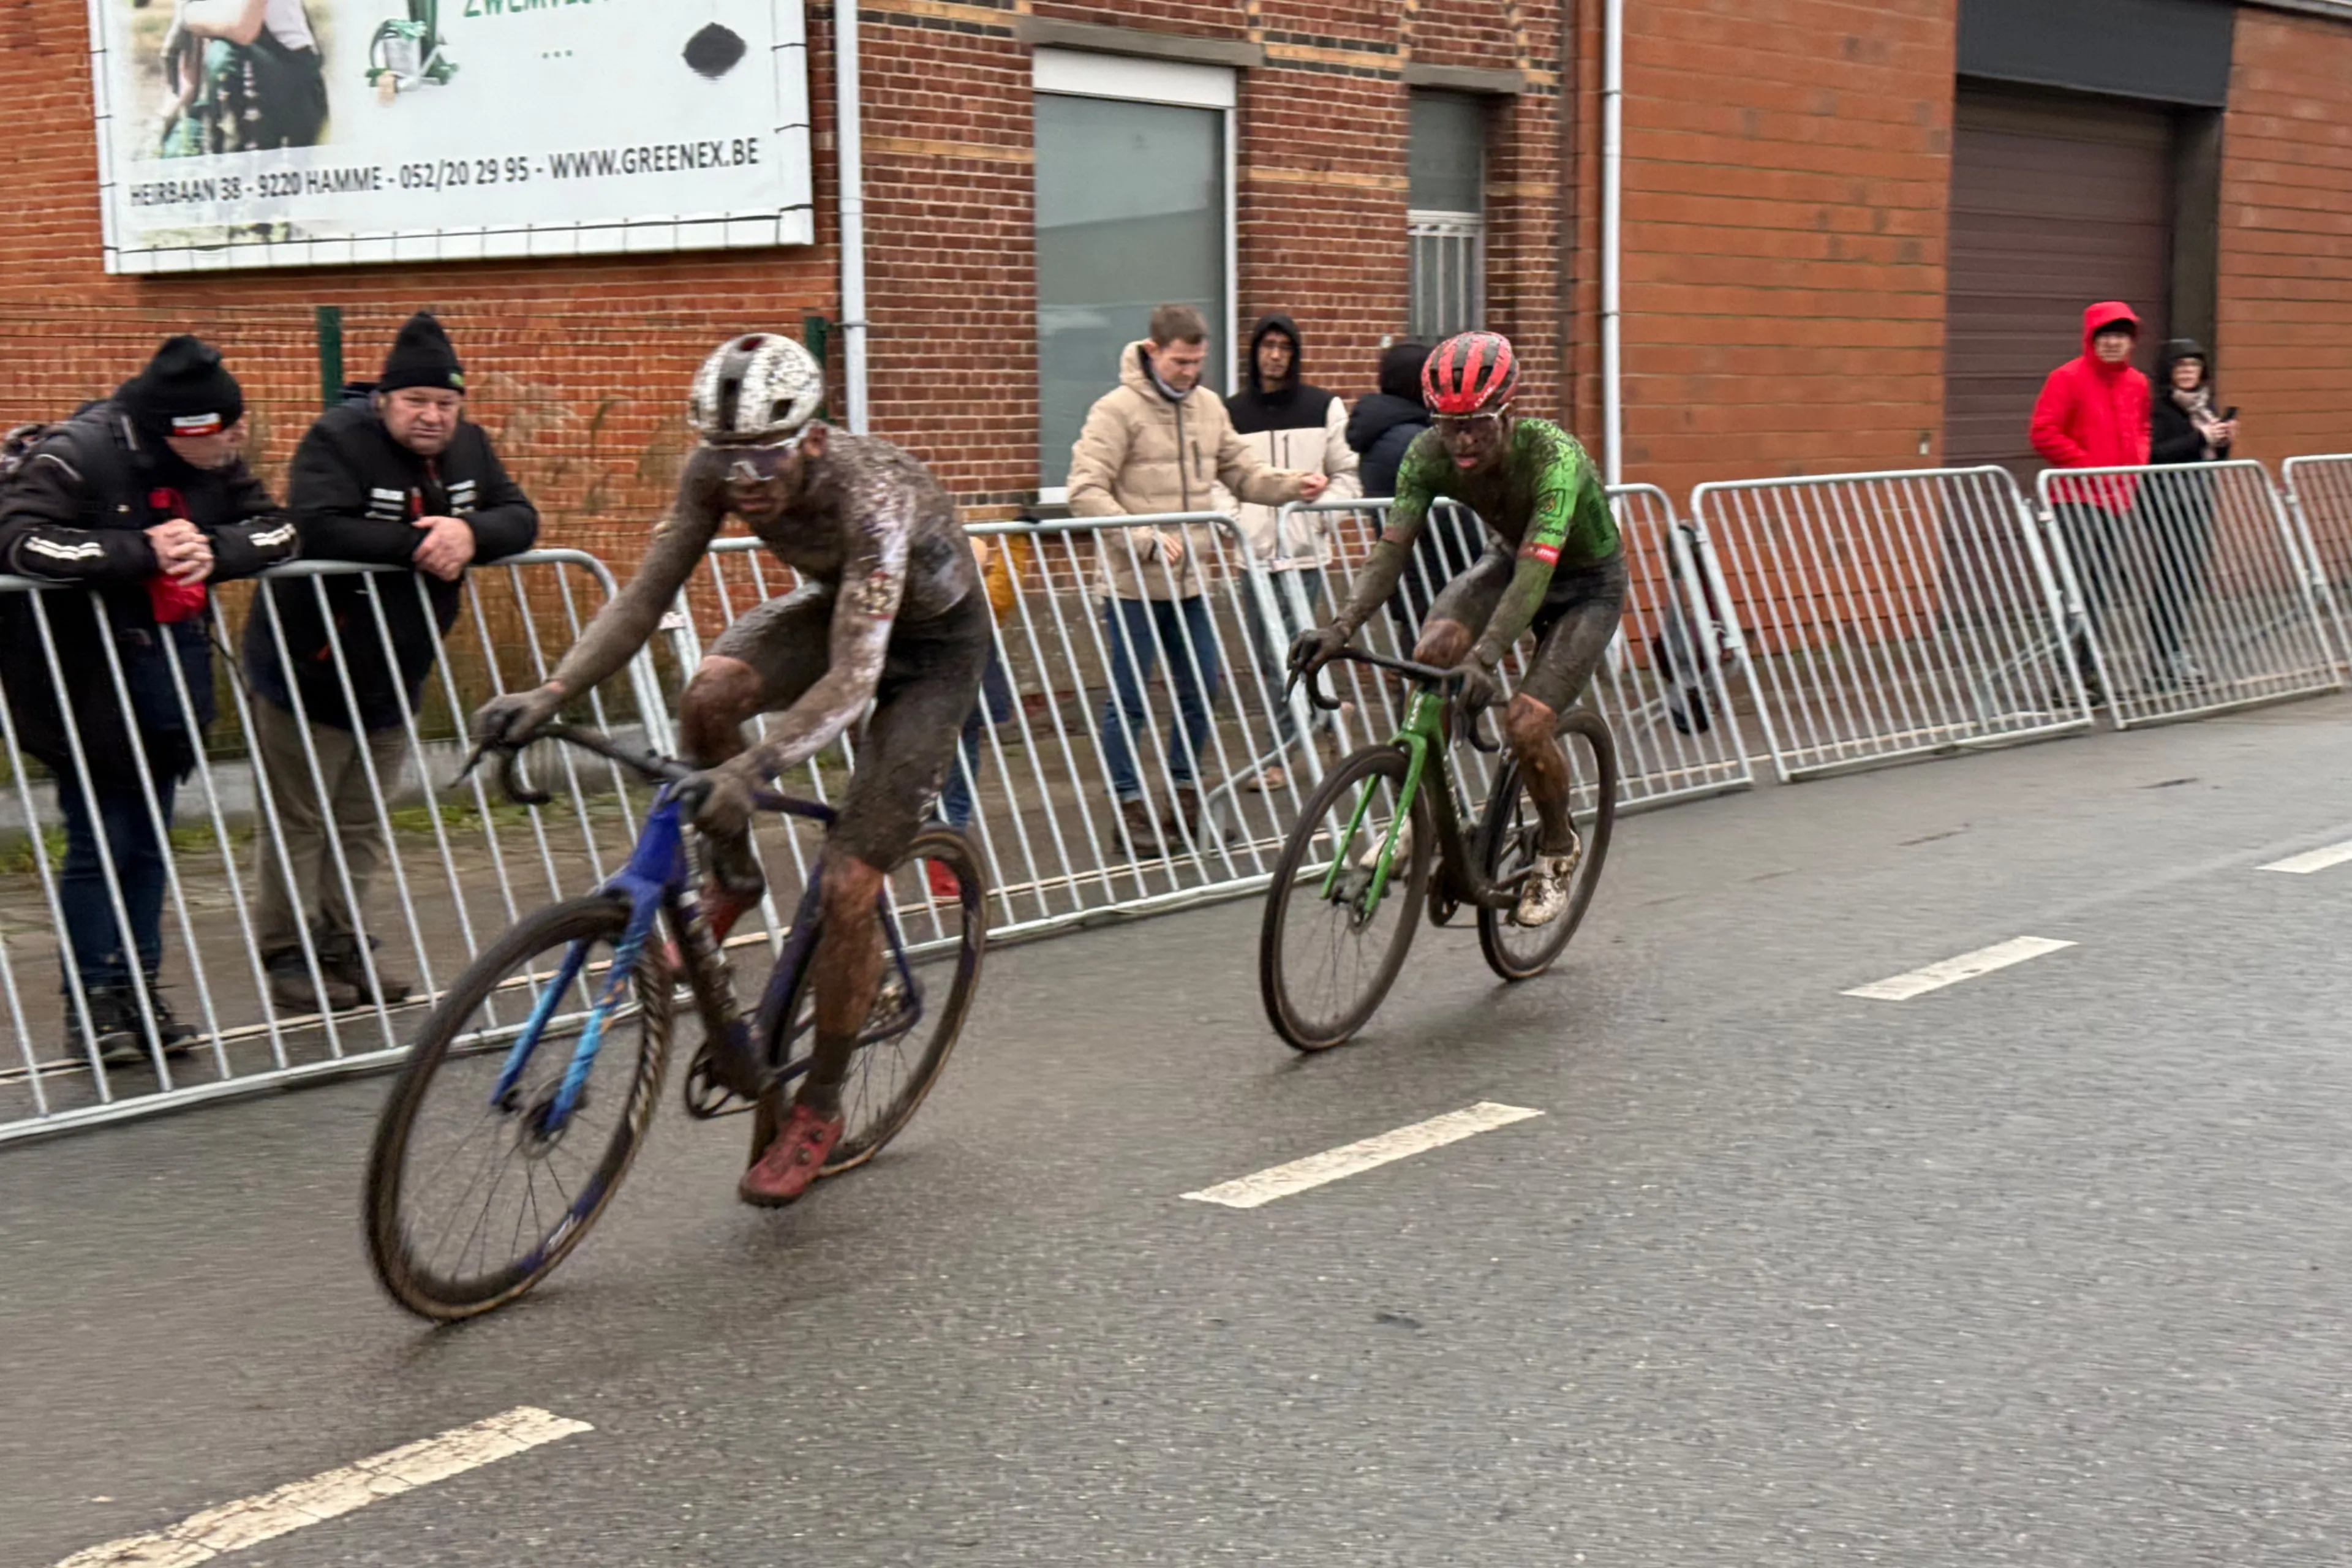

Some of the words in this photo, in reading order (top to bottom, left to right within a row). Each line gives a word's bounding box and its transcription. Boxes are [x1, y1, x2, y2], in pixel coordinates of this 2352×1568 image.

[130, 179, 216, 206] HEIRBAAN
[257, 172, 302, 198] 9220
[306, 166, 382, 194] HAMME
[400, 159, 469, 192] 052/20
[476, 158, 498, 186] 29
[505, 156, 529, 183] 95
[549, 137, 760, 179] WWW.GREENEX.BE
